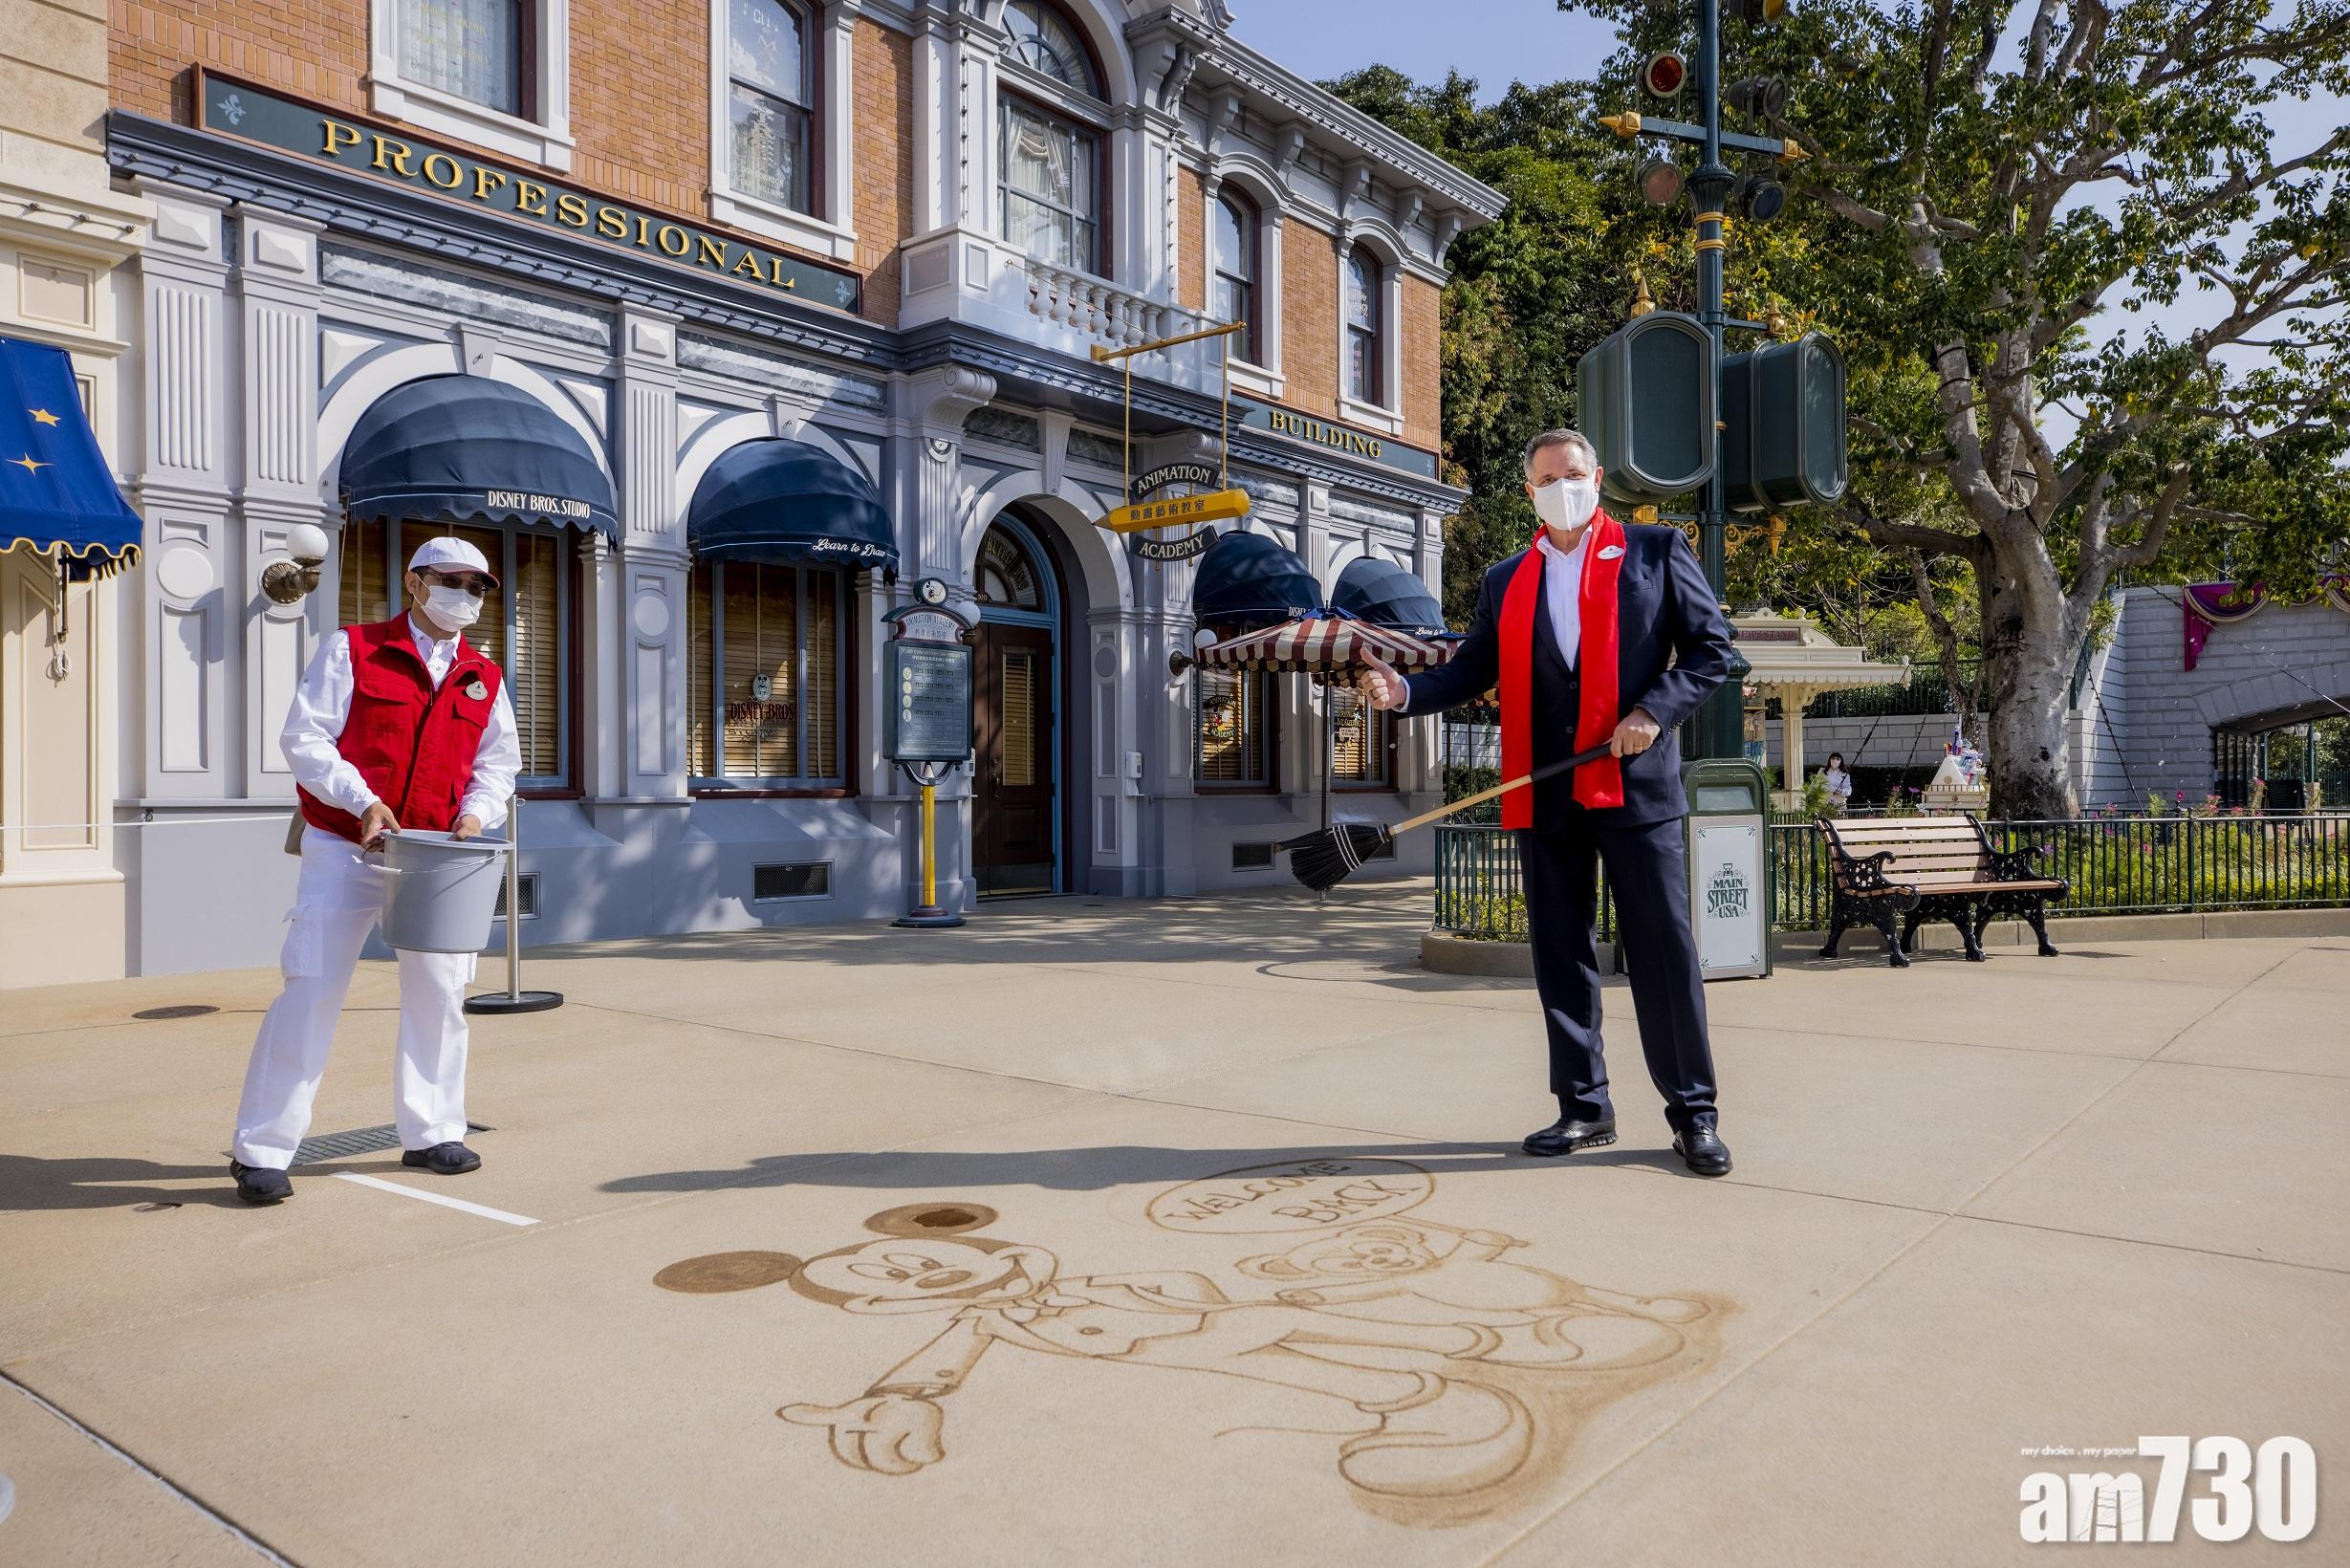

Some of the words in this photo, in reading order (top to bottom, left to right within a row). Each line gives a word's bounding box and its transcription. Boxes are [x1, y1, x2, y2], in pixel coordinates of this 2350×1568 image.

[321, 119, 795, 289] PROFESSIONAL
[1271, 409, 1382, 459] BUILDING
[1138, 465, 1211, 495] ANIMATION
[488, 490, 527, 510] DISNEY
[530, 494, 560, 514] BROS.
[561, 499, 590, 519] STUDIO
[812, 538, 849, 552] Learn
[851, 543, 860, 553] to
[860, 543, 886, 557] Draw
[1140, 534, 1206, 558] ACADEMY
[730, 703, 765, 720] DISNEY
[1713, 878, 1743, 889] MAIN
[1707, 887, 1749, 914] STREET
[1718, 905, 1740, 919] USA
[1164, 1162, 1352, 1221] WELCOME
[1271, 1179, 1423, 1224] BACK
